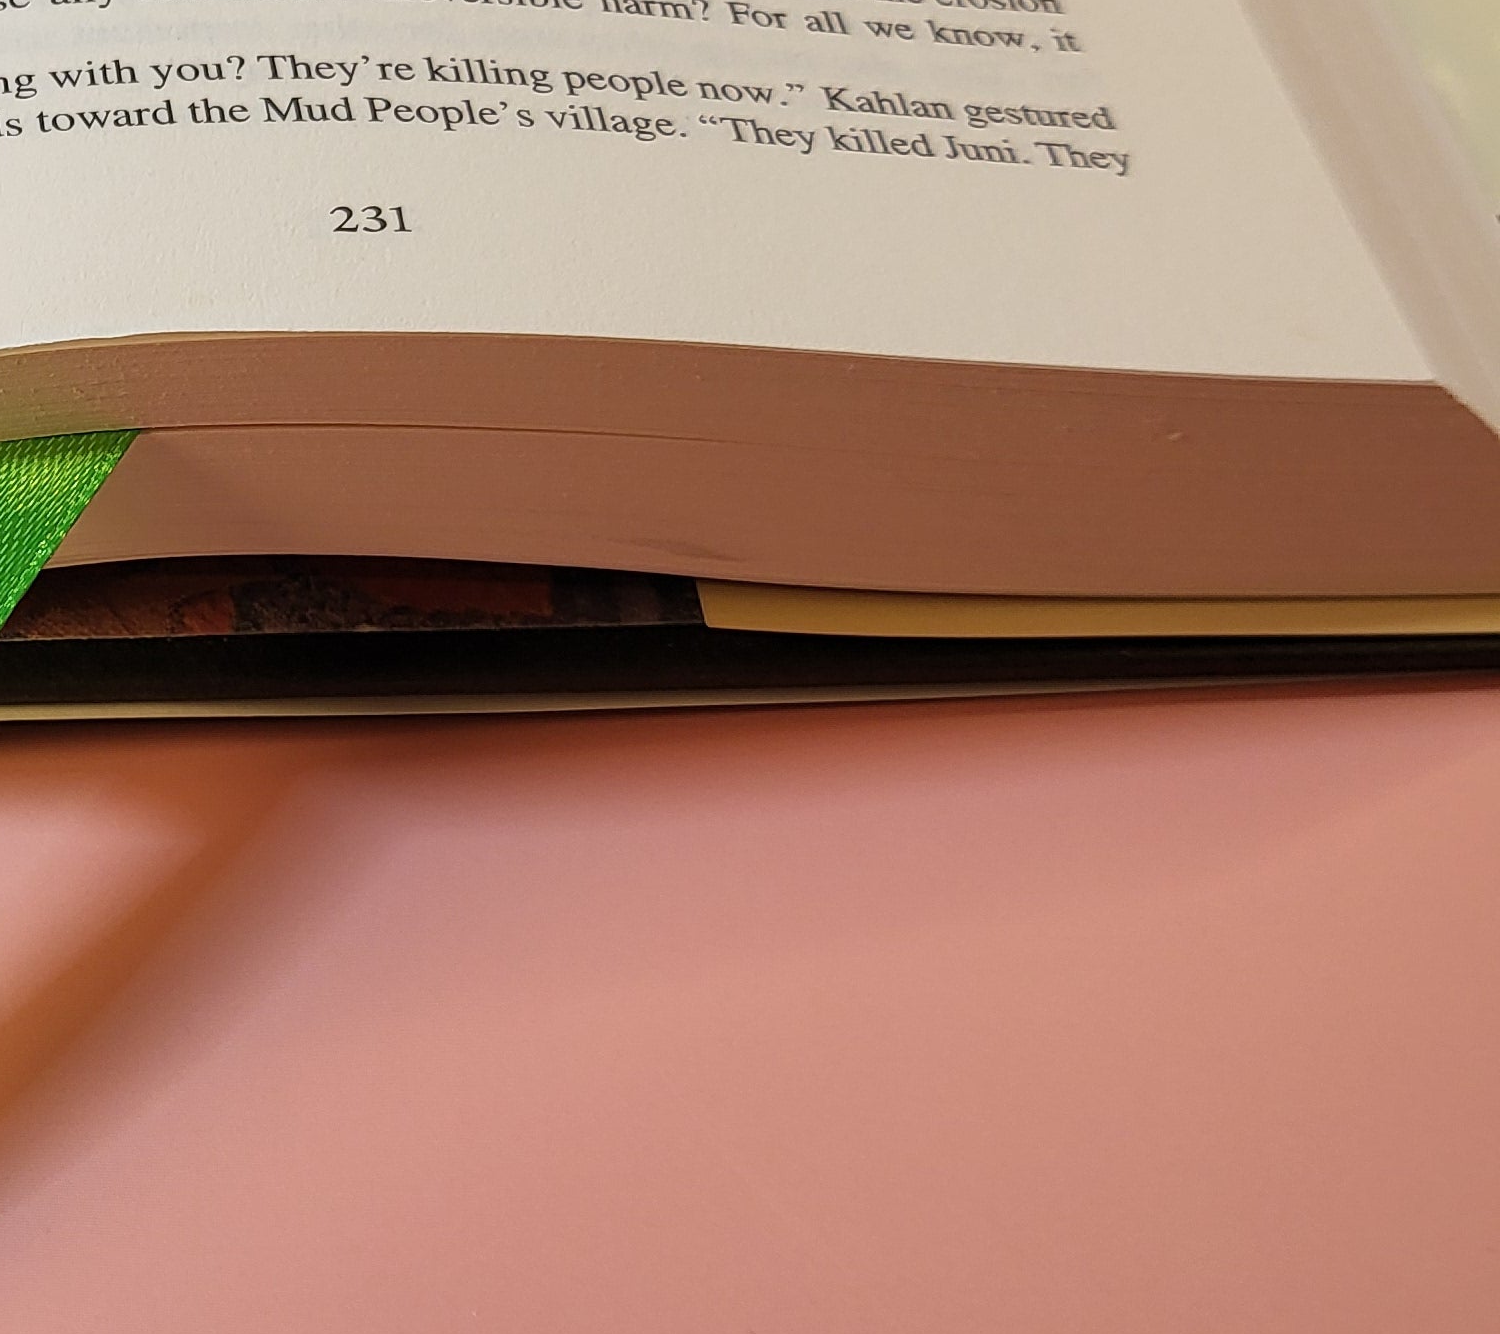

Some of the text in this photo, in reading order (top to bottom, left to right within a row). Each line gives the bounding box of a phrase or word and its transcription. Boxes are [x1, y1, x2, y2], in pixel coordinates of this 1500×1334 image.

[723, 0, 789, 30] For
[803, 9, 852, 36] all
[861, 20, 918, 41] we
[923, 18, 1043, 53] know,
[1049, 27, 1084, 53] it
[47, 58, 141, 89] with
[148, 54, 246, 91] you?
[255, 53, 417, 88] They’re
[421, 55, 555, 95] killing
[560, 70, 689, 102] people
[694, 81, 806, 107] now.”
[817, 85, 957, 121] Kahlan
[962, 103, 1119, 131] gestured
[35, 98, 179, 134] toward
[186, 96, 252, 125] the
[258, 95, 357, 123] Mud
[362, 96, 536, 132] People’s
[543, 104, 690, 142] village.
[697, 113, 817, 156] “They
[822, 125, 938, 158] killed
[939, 134, 1034, 165] Juni.
[1032, 140, 1131, 178] They
[329, 204, 413, 234] 231
